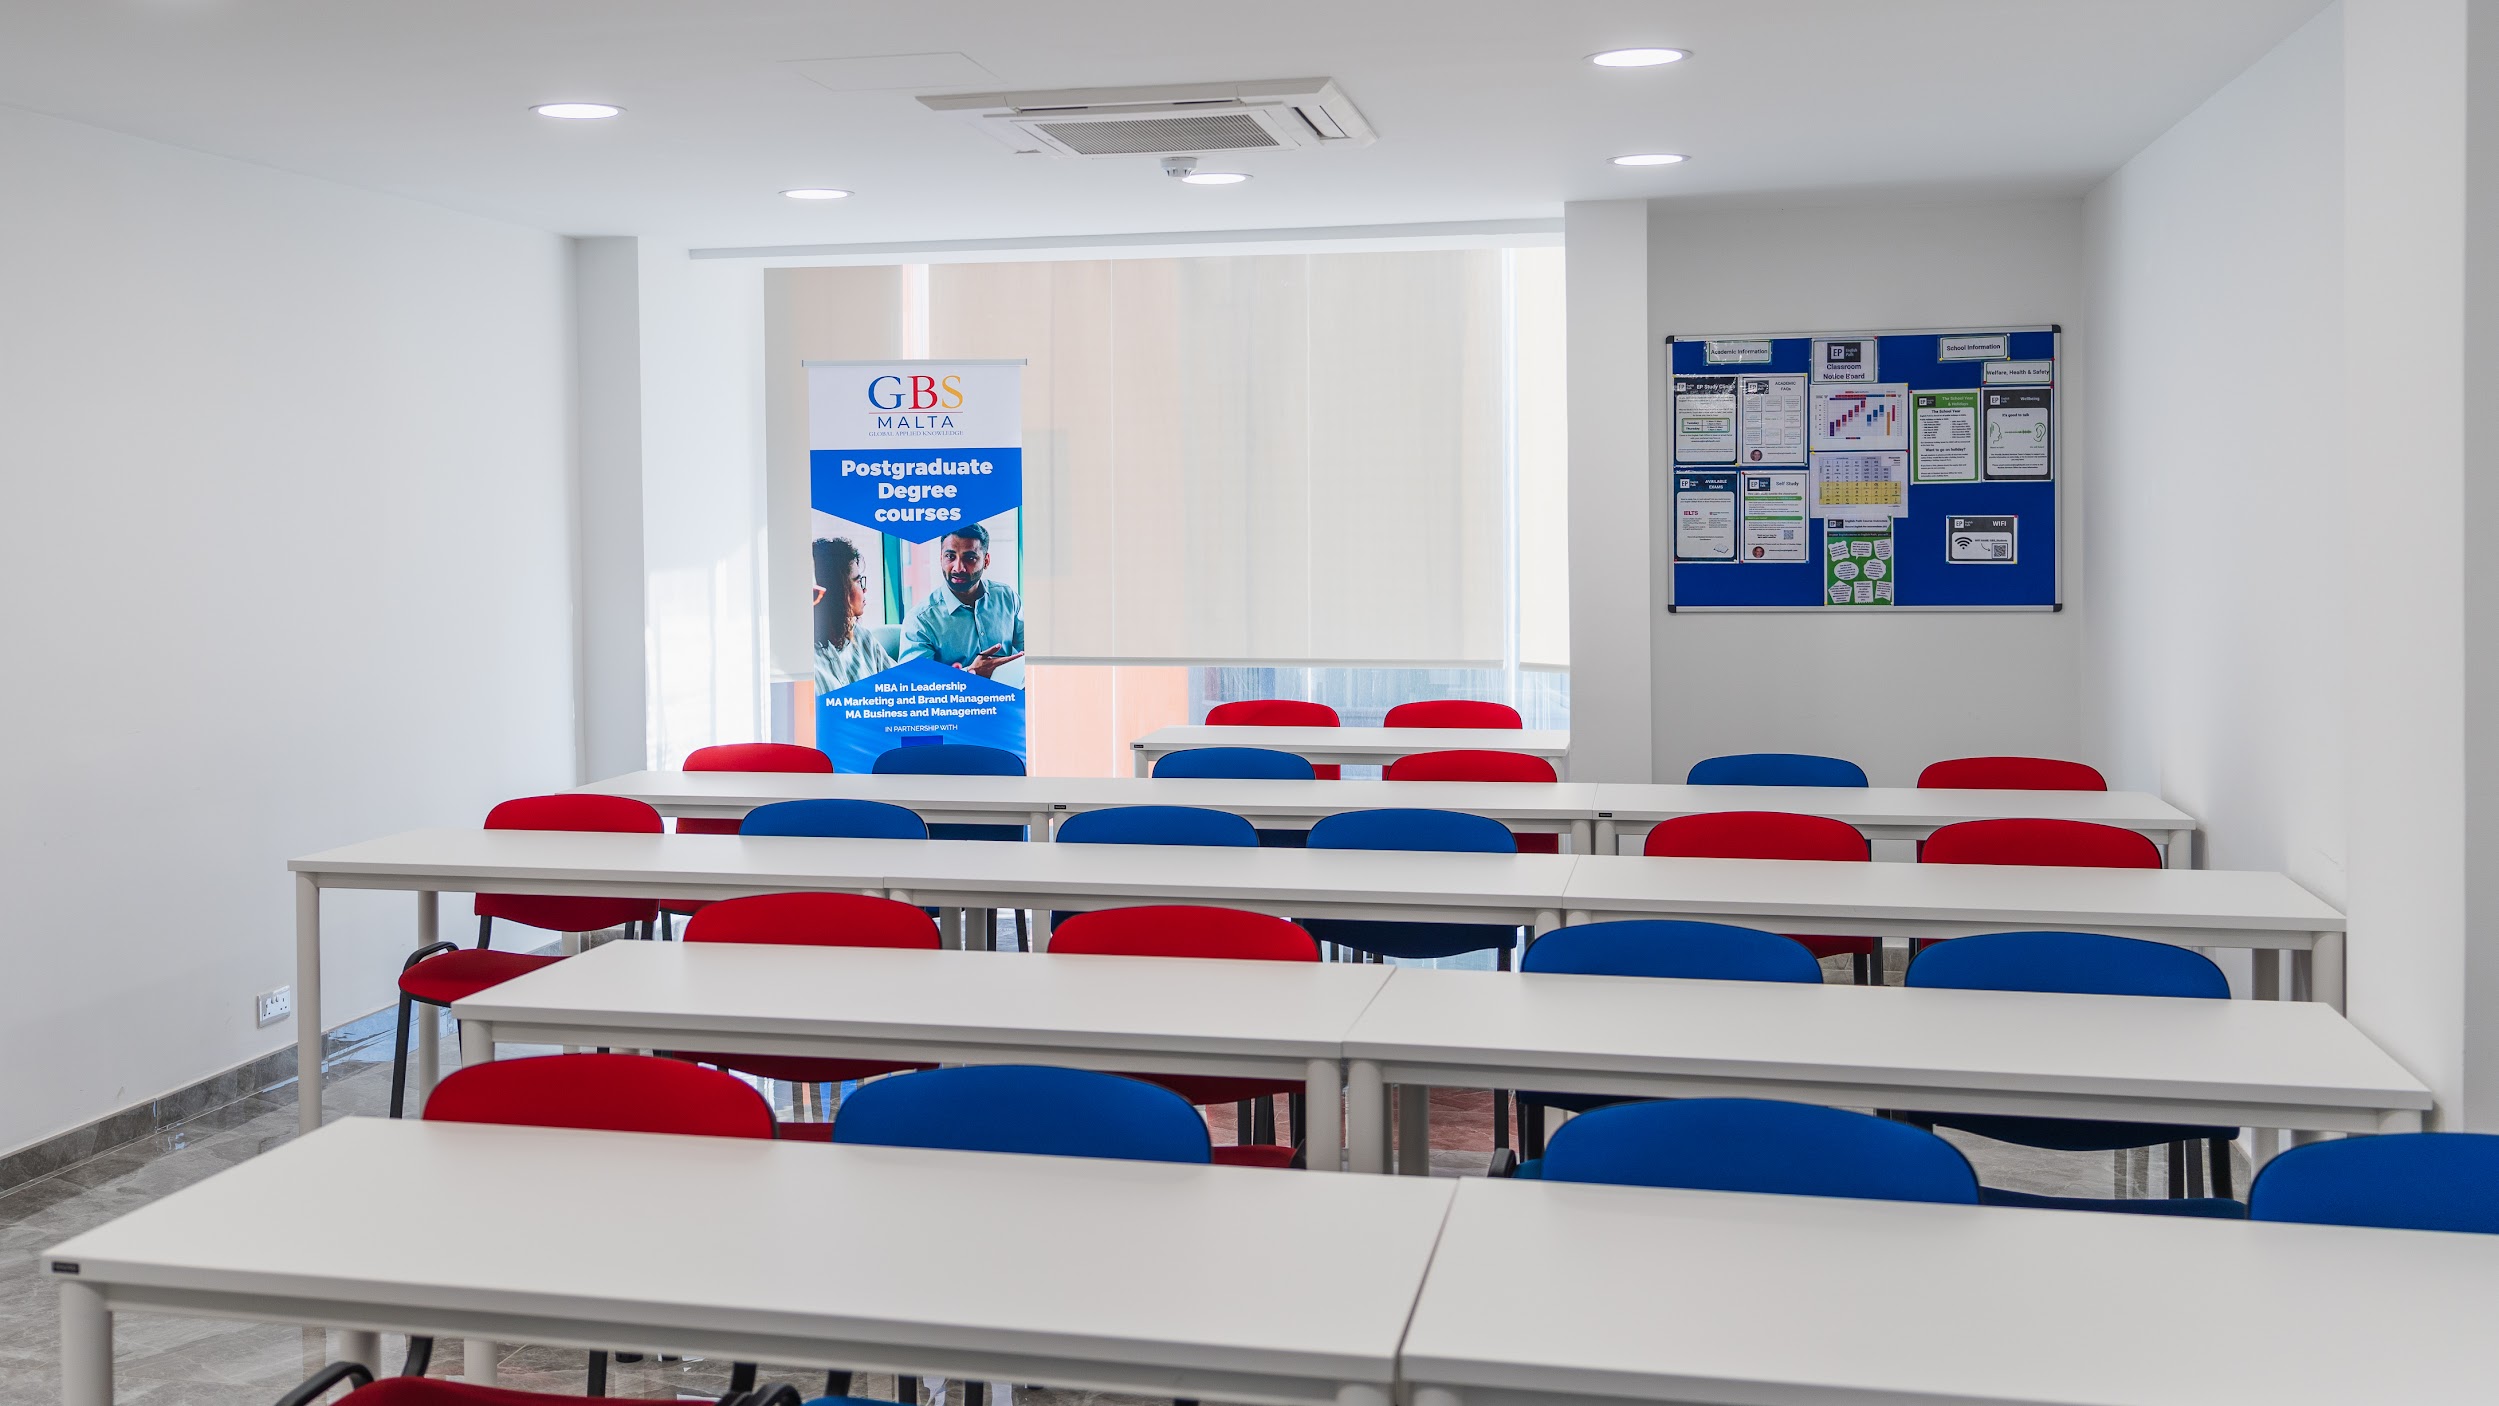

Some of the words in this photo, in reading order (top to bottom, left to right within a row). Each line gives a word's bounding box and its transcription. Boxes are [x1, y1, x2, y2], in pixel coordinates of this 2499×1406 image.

[1833, 348, 1843, 357] EP
[1967, 343, 2001, 351] Information
[868, 375, 964, 410] GBS
[878, 415, 954, 429] MALTA
[841, 458, 993, 480] Postgraduate
[878, 482, 957, 502] Degree
[874, 506, 962, 522] courses
[874, 683, 898, 693] MBA
[899, 682, 909, 692] in
[910, 681, 967, 692] Leadership
[825, 697, 842, 707] MA
[843, 696, 895, 707] Marketing
[896, 695, 917, 705] and
[917, 694, 948, 705] Brand
[949, 692, 1016, 705] Management
[845, 709, 862, 719] MA
[863, 708, 908, 719] Business
[909, 707, 930, 717] and
[930, 706, 997, 718] Management
[893, 724, 939, 732] PARTNERSHIP
